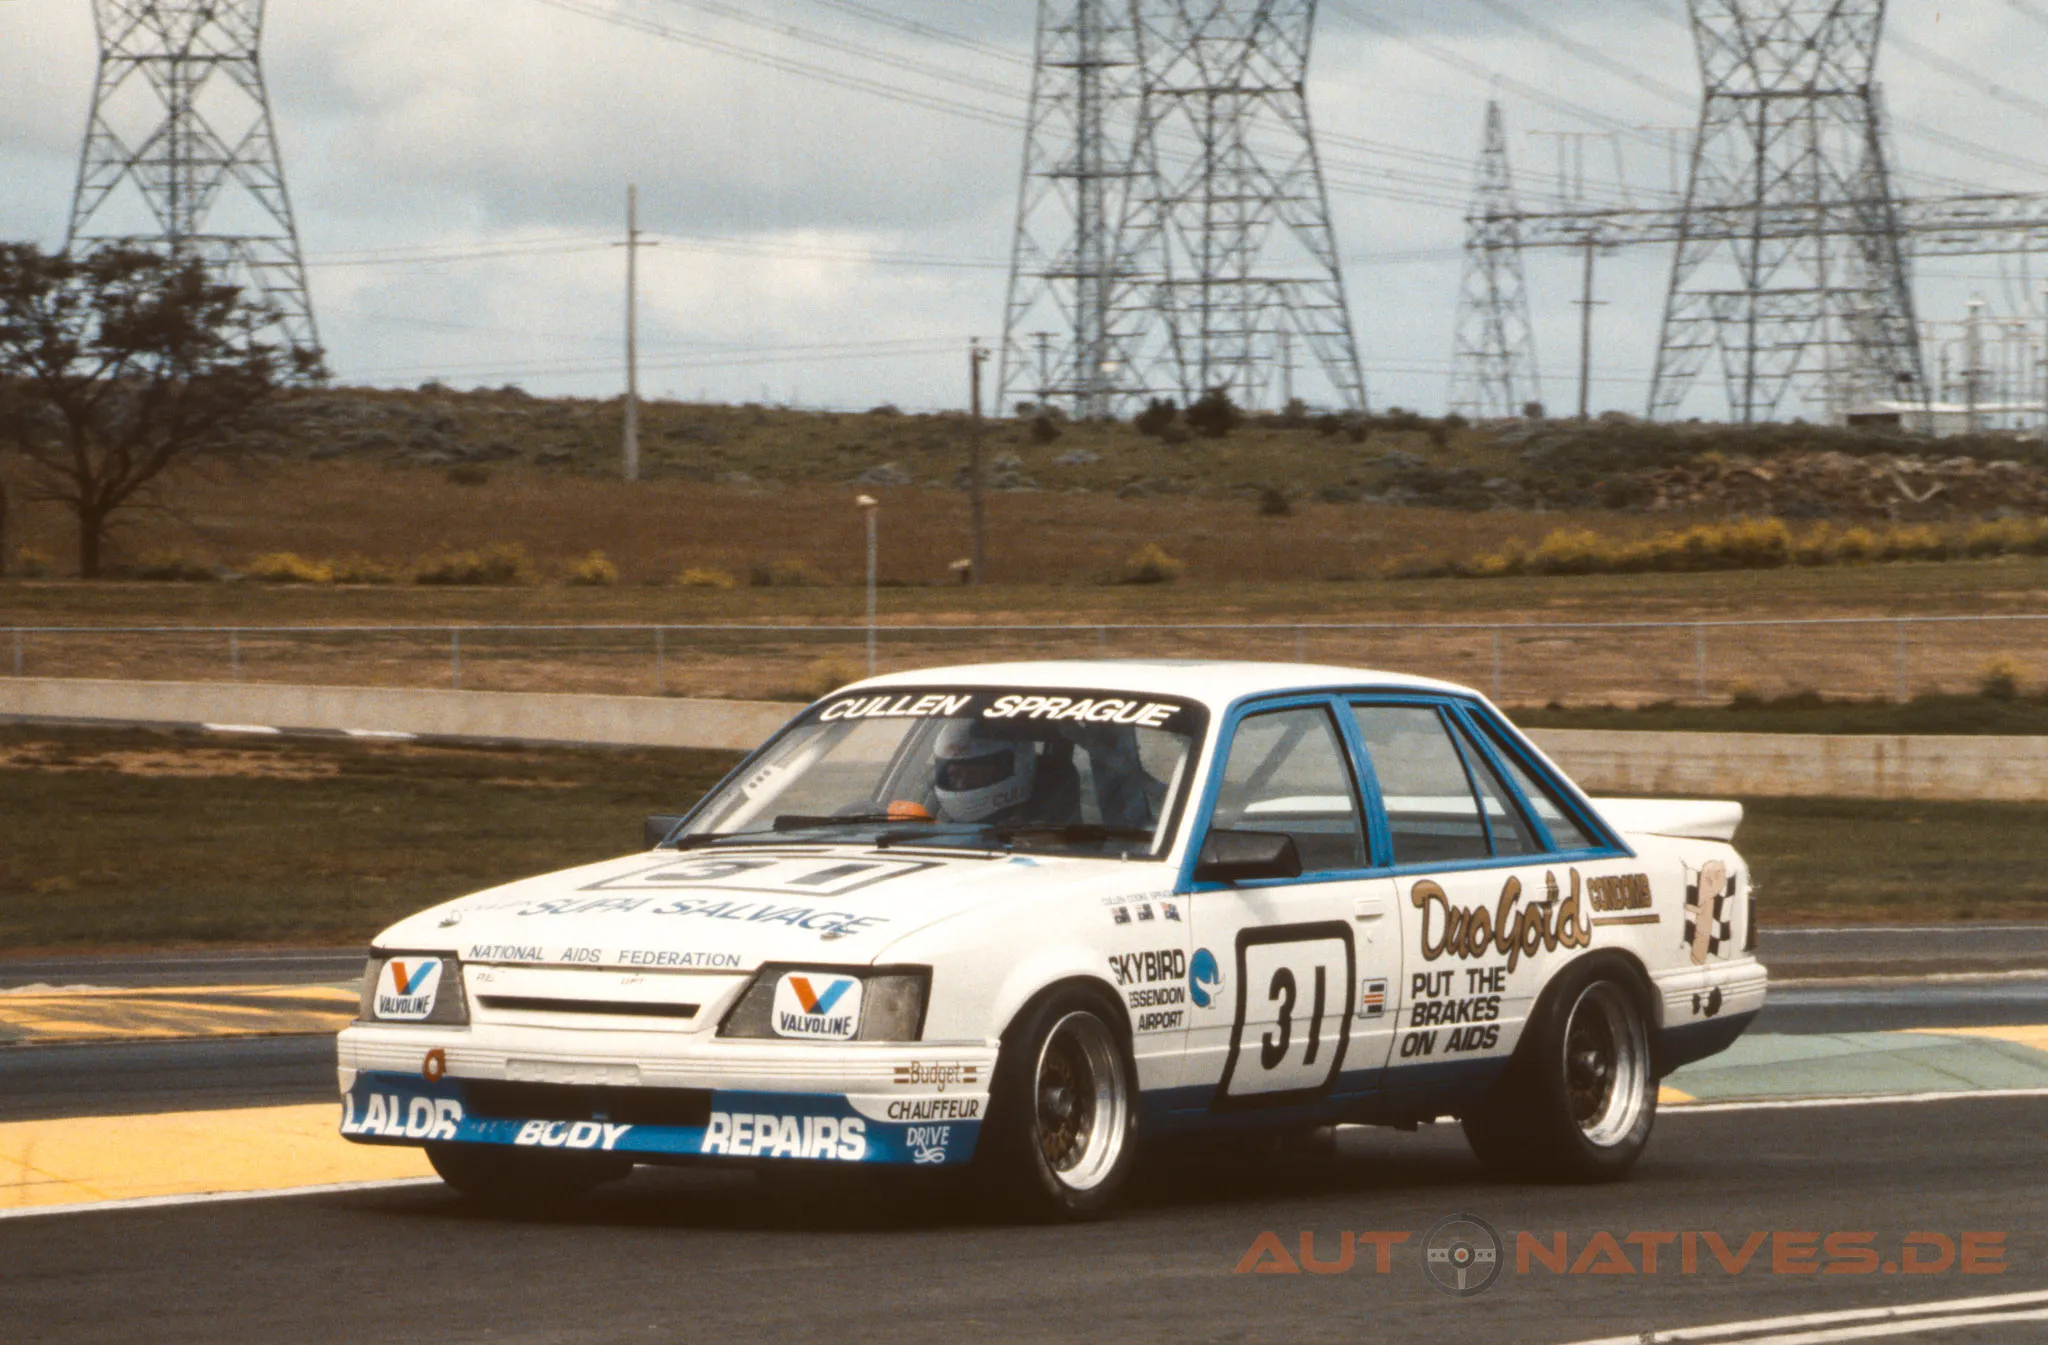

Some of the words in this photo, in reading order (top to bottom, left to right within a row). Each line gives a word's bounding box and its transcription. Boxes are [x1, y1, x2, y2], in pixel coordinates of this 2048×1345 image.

[819, 695, 973, 721] CULLEN
[982, 695, 1180, 727] SPRAGUE
[644, 860, 884, 886] 31
[652, 899, 891, 934] SALVAGE
[469, 944, 544, 961] NATIONAL
[560, 948, 600, 963] AIDS
[618, 950, 741, 967] FEDERATION
[1108, 948, 1186, 986] SKYBIRD
[1128, 986, 1185, 1009] ESSENDON
[1411, 970, 1454, 999] PUT
[1466, 966, 1506, 993] THE
[379, 995, 430, 1015] VALVOLINE
[1138, 1011, 1183, 1031] AIRPORT
[1261, 965, 1325, 1070] 31
[1410, 995, 1501, 1027] BRAKES
[780, 1012, 851, 1035] VALVOLINE
[1401, 1031, 1437, 1058] ON
[1444, 1024, 1500, 1051] AIDS
[909, 1061, 961, 1091] Budget
[887, 1099, 980, 1121] CHAUFFEUR
[341, 1092, 463, 1141] LALOR
[514, 1119, 633, 1150] BODY
[701, 1111, 866, 1161] REPAIRS
[907, 1126, 950, 1163] DRIVE
